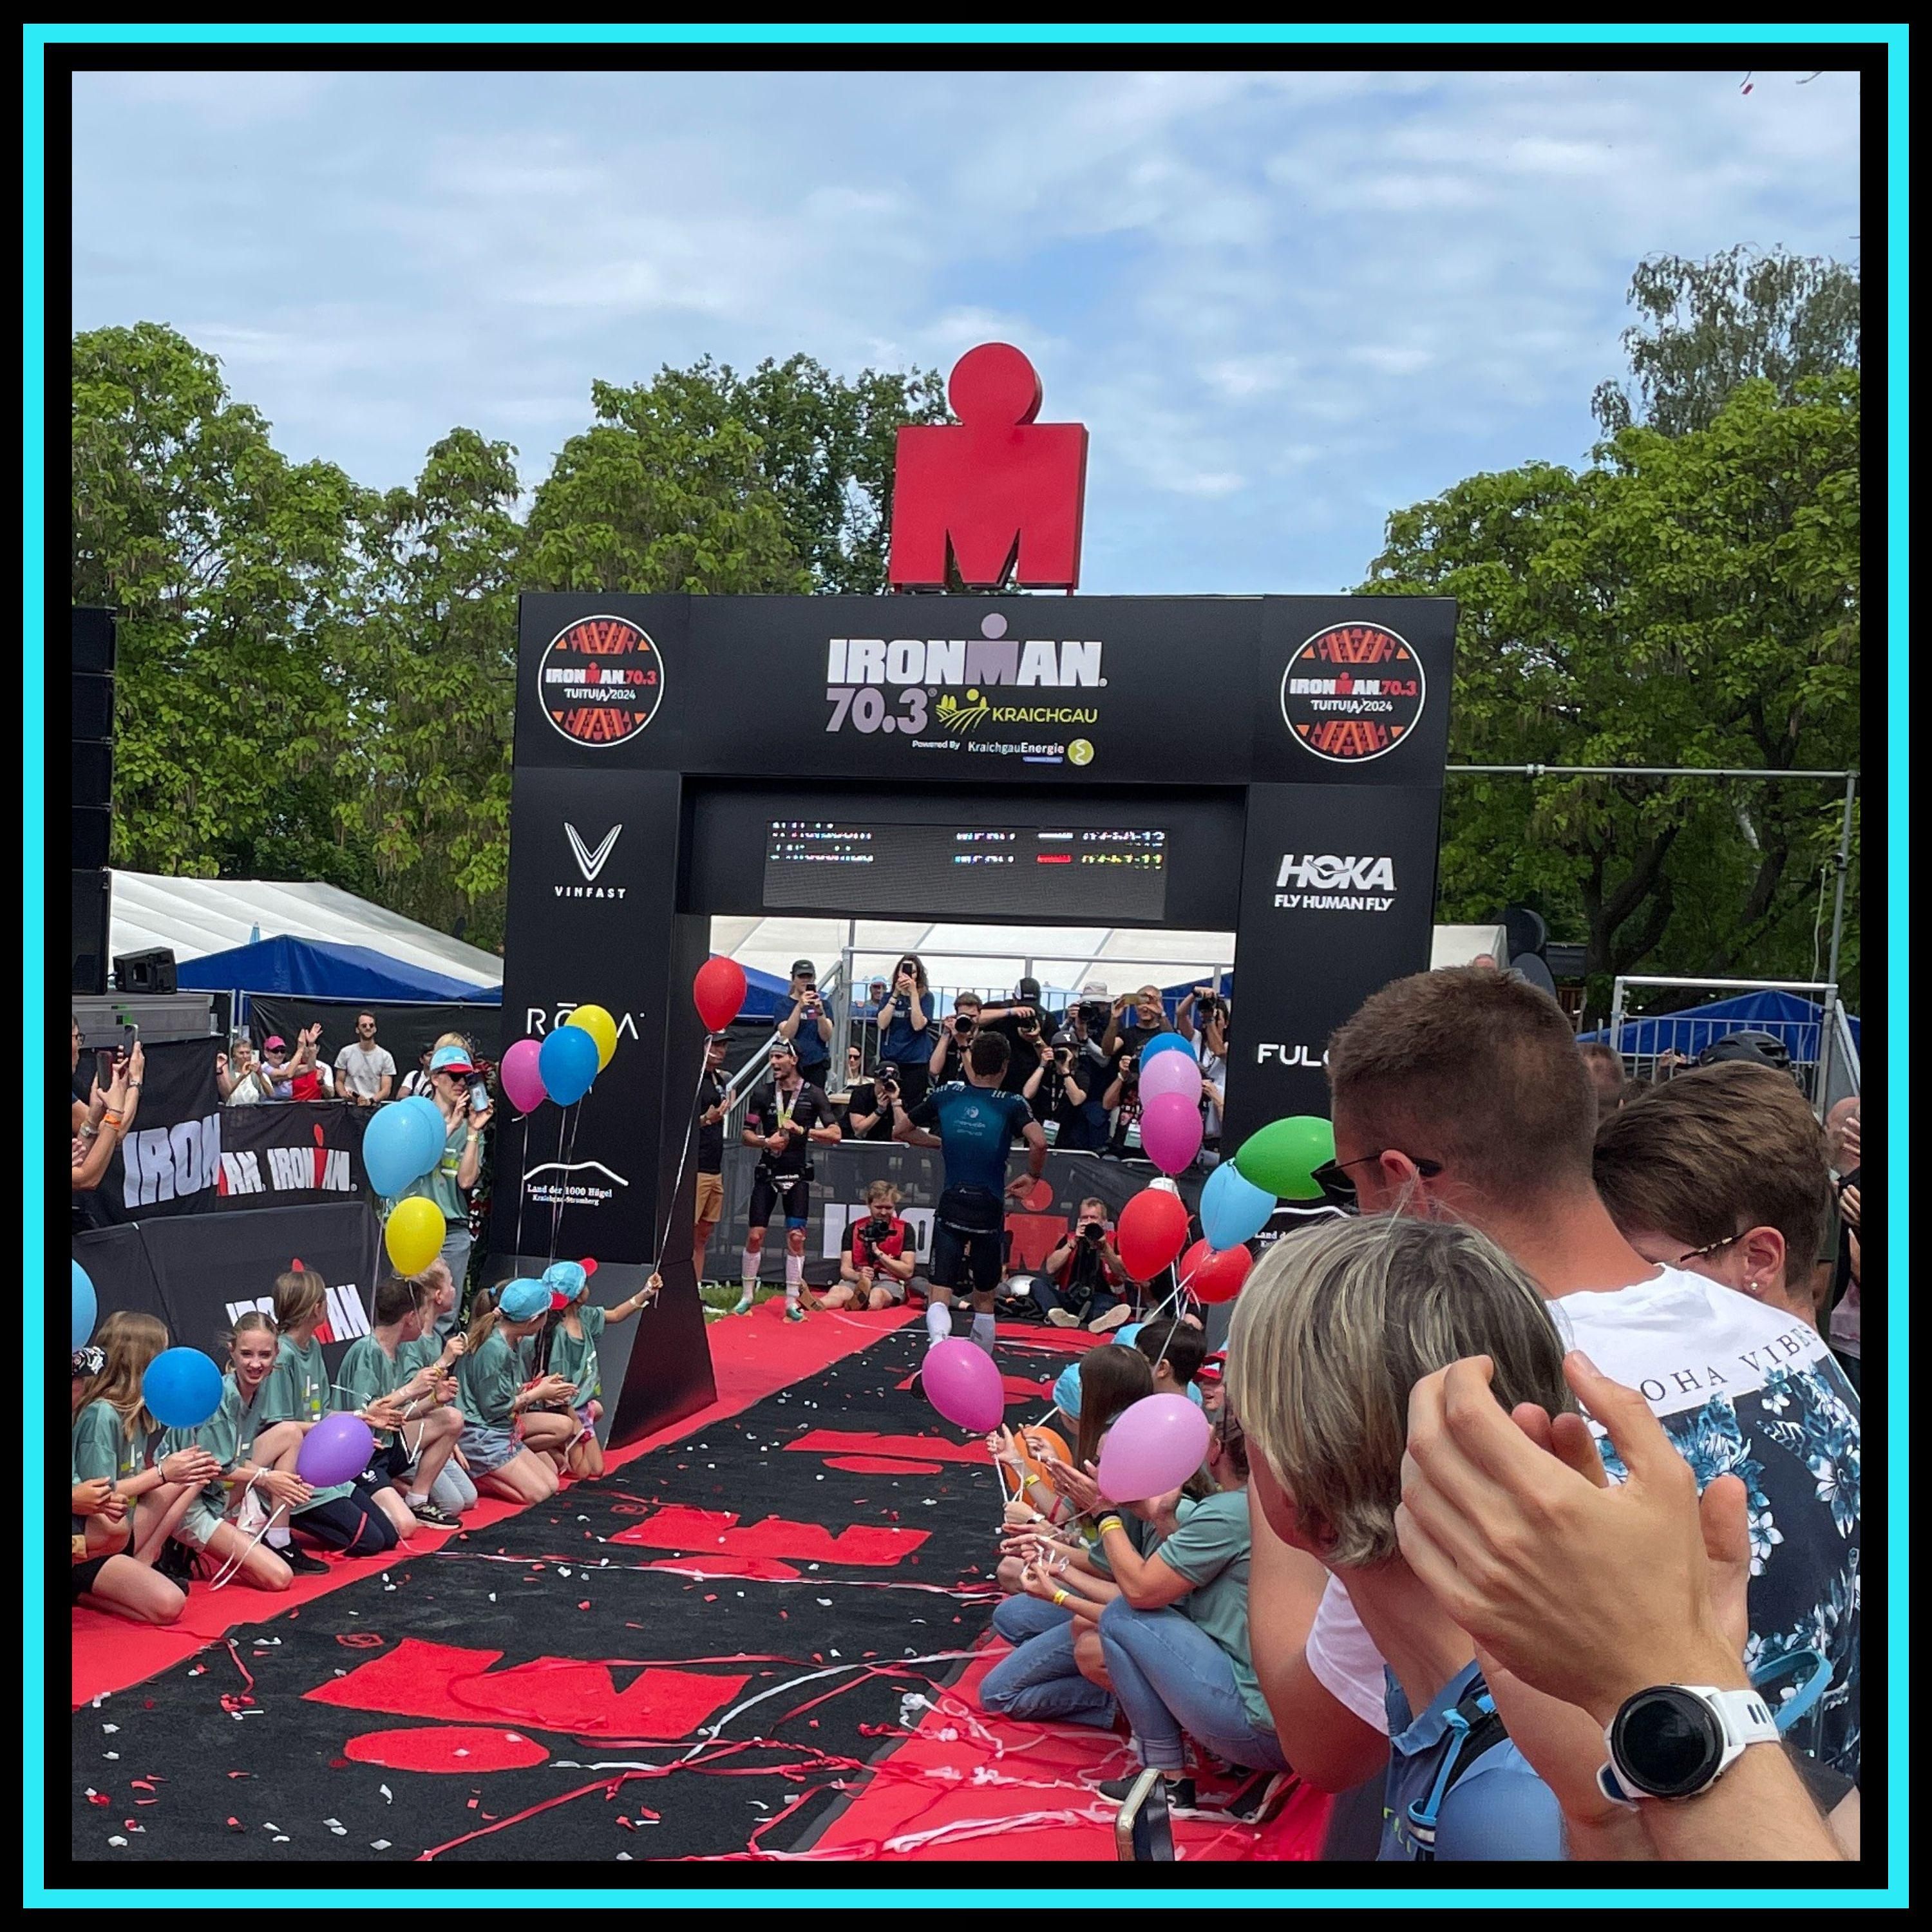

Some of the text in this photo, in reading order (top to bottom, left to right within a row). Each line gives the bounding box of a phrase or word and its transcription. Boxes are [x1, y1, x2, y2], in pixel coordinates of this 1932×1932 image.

[827, 612, 1102, 687] IRONMAN
[545, 661, 657, 685] IRONMAN 70.3
[1289, 672, 1417, 696] IRONMAN 70.3
[611, 689, 636, 700] 2024
[1365, 700, 1393, 712] 2024
[826, 687, 1098, 734] 70.3 KRAICHGAU
[968, 741, 1065, 755] KraichgauEnergie
[1276, 854, 1394, 891] HOKA
[554, 886, 626, 899] VINFAST
[1274, 894, 1394, 911] FLY HUMAN FLY
[1258, 1043, 1329, 1067] FUL
[122, 1112, 221, 1209] IRON
[527, 1184, 612, 1198] Land der 1000 Hügel
[1739, 1324, 1818, 1372] VIBES
